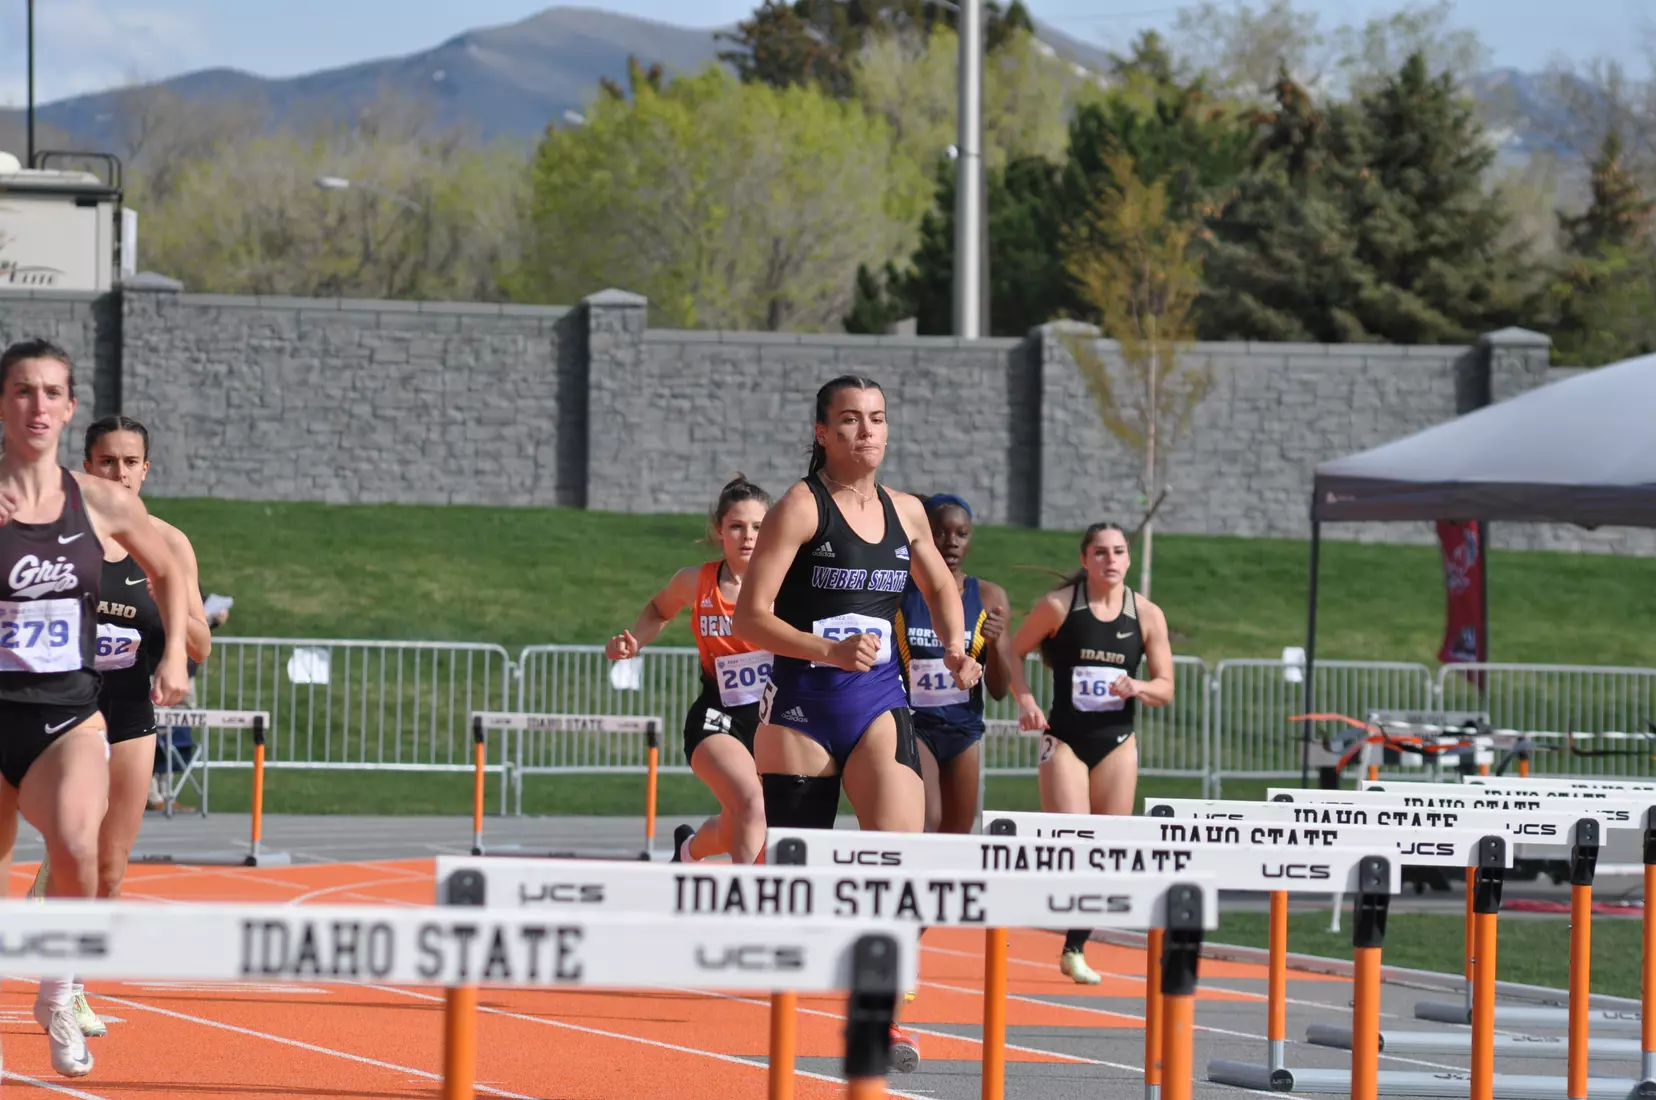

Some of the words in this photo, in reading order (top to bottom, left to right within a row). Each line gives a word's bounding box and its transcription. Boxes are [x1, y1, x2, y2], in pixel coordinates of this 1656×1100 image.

[8, 554, 79, 593] Griz
[811, 565, 868, 590] WEBER
[867, 569, 908, 593] STATE
[97, 600, 137, 619] AHO
[0, 619, 70, 649] 279
[700, 615, 733, 637] BEN
[96, 636, 133, 657] 62
[1080, 648, 1126, 665] IDAHO
[722, 663, 773, 690] 209
[917, 671, 957, 691] 41
[833, 849, 902, 866] UCS
[981, 844, 1075, 871] IDAHO
[1088, 848, 1192, 872] STATE
[1262, 863, 1332, 880] UCS
[518, 882, 606, 905] UCS
[674, 874, 814, 915] IDAHO
[833, 878, 988, 923] STATE
[1047, 893, 1132, 914] UCS
[0, 931, 110, 960] UCS
[239, 918, 396, 978] IDAHO
[414, 922, 584, 982] STATE
[694, 943, 807, 971] UCS
